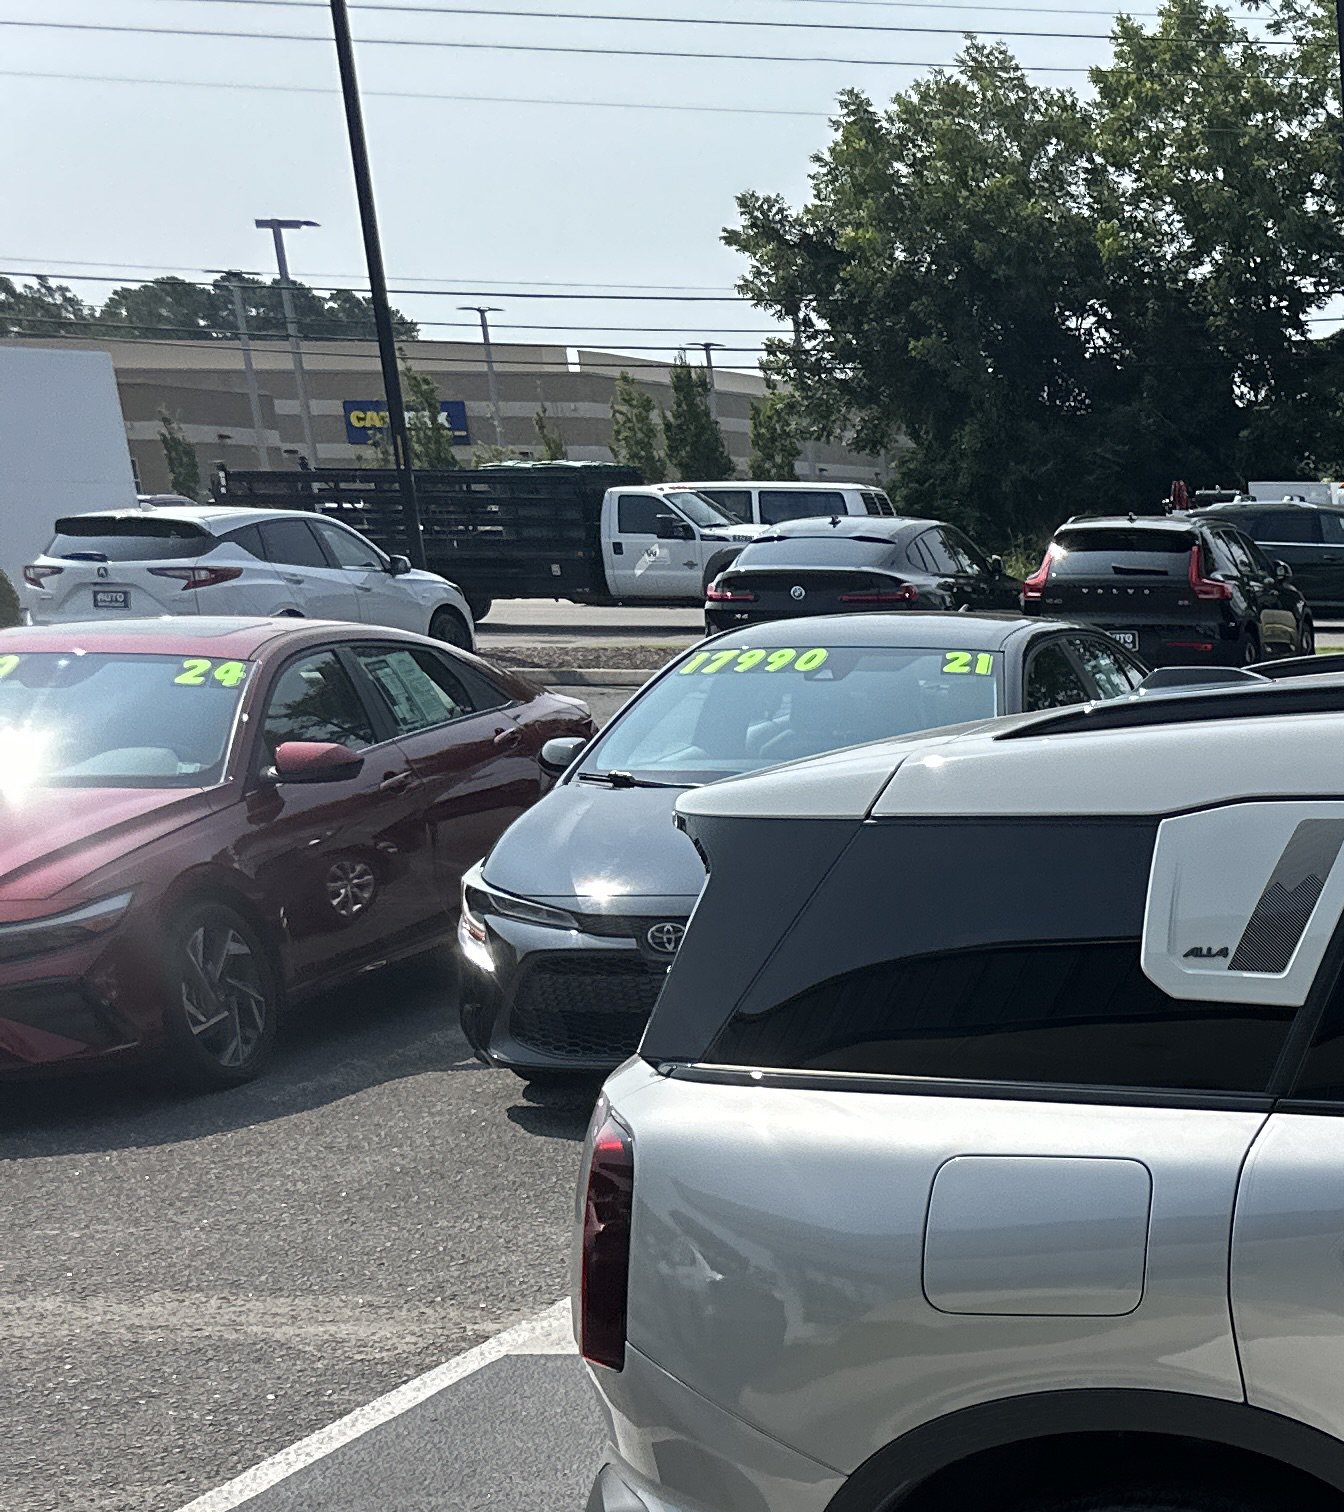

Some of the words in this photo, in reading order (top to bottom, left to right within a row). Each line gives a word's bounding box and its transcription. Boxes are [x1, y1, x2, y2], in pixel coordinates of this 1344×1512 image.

[97, 592, 124, 602] AUTO
[679, 648, 829, 675] 17990
[941, 651, 994, 676] 21
[174, 659, 247, 687] 24
[1182, 946, 1230, 958] ALL4
